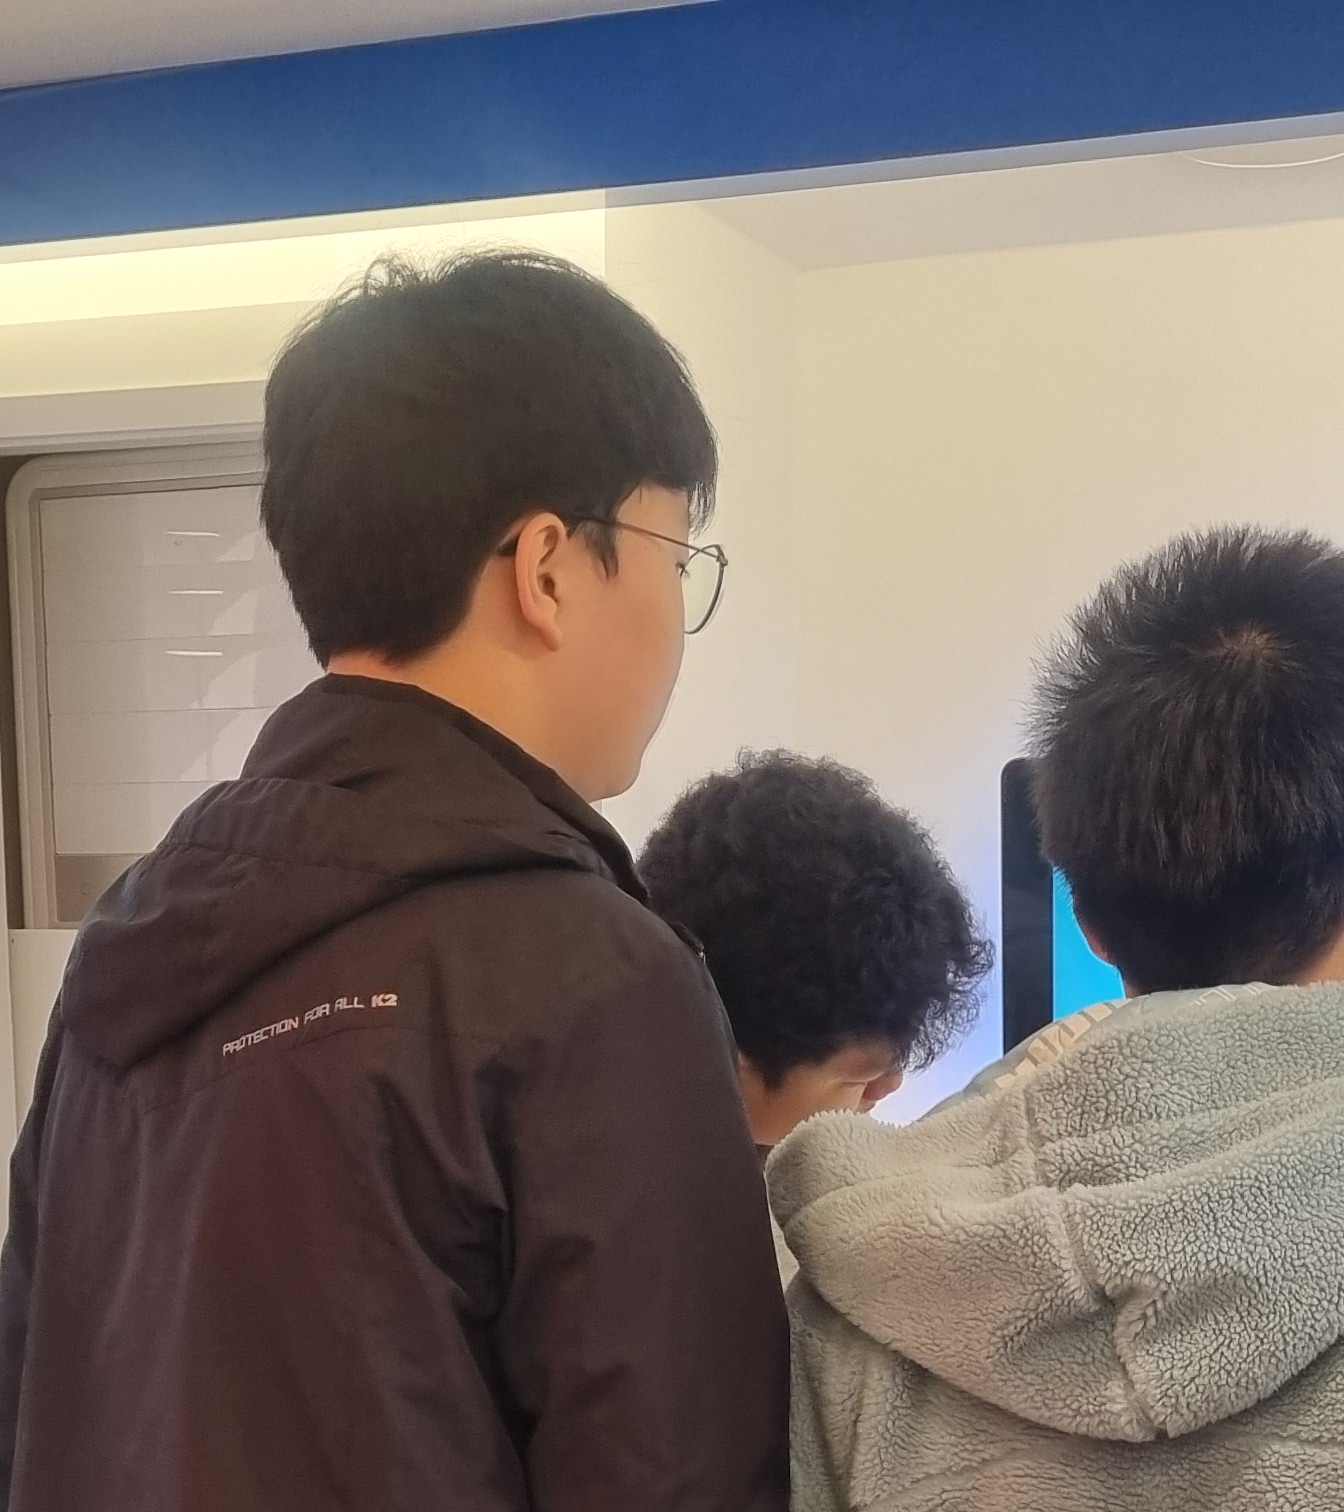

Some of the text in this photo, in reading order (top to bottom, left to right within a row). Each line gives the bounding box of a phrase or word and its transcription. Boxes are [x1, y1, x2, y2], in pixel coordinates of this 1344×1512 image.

[222, 993, 398, 1056] PROTECTION FOR ALL K2
